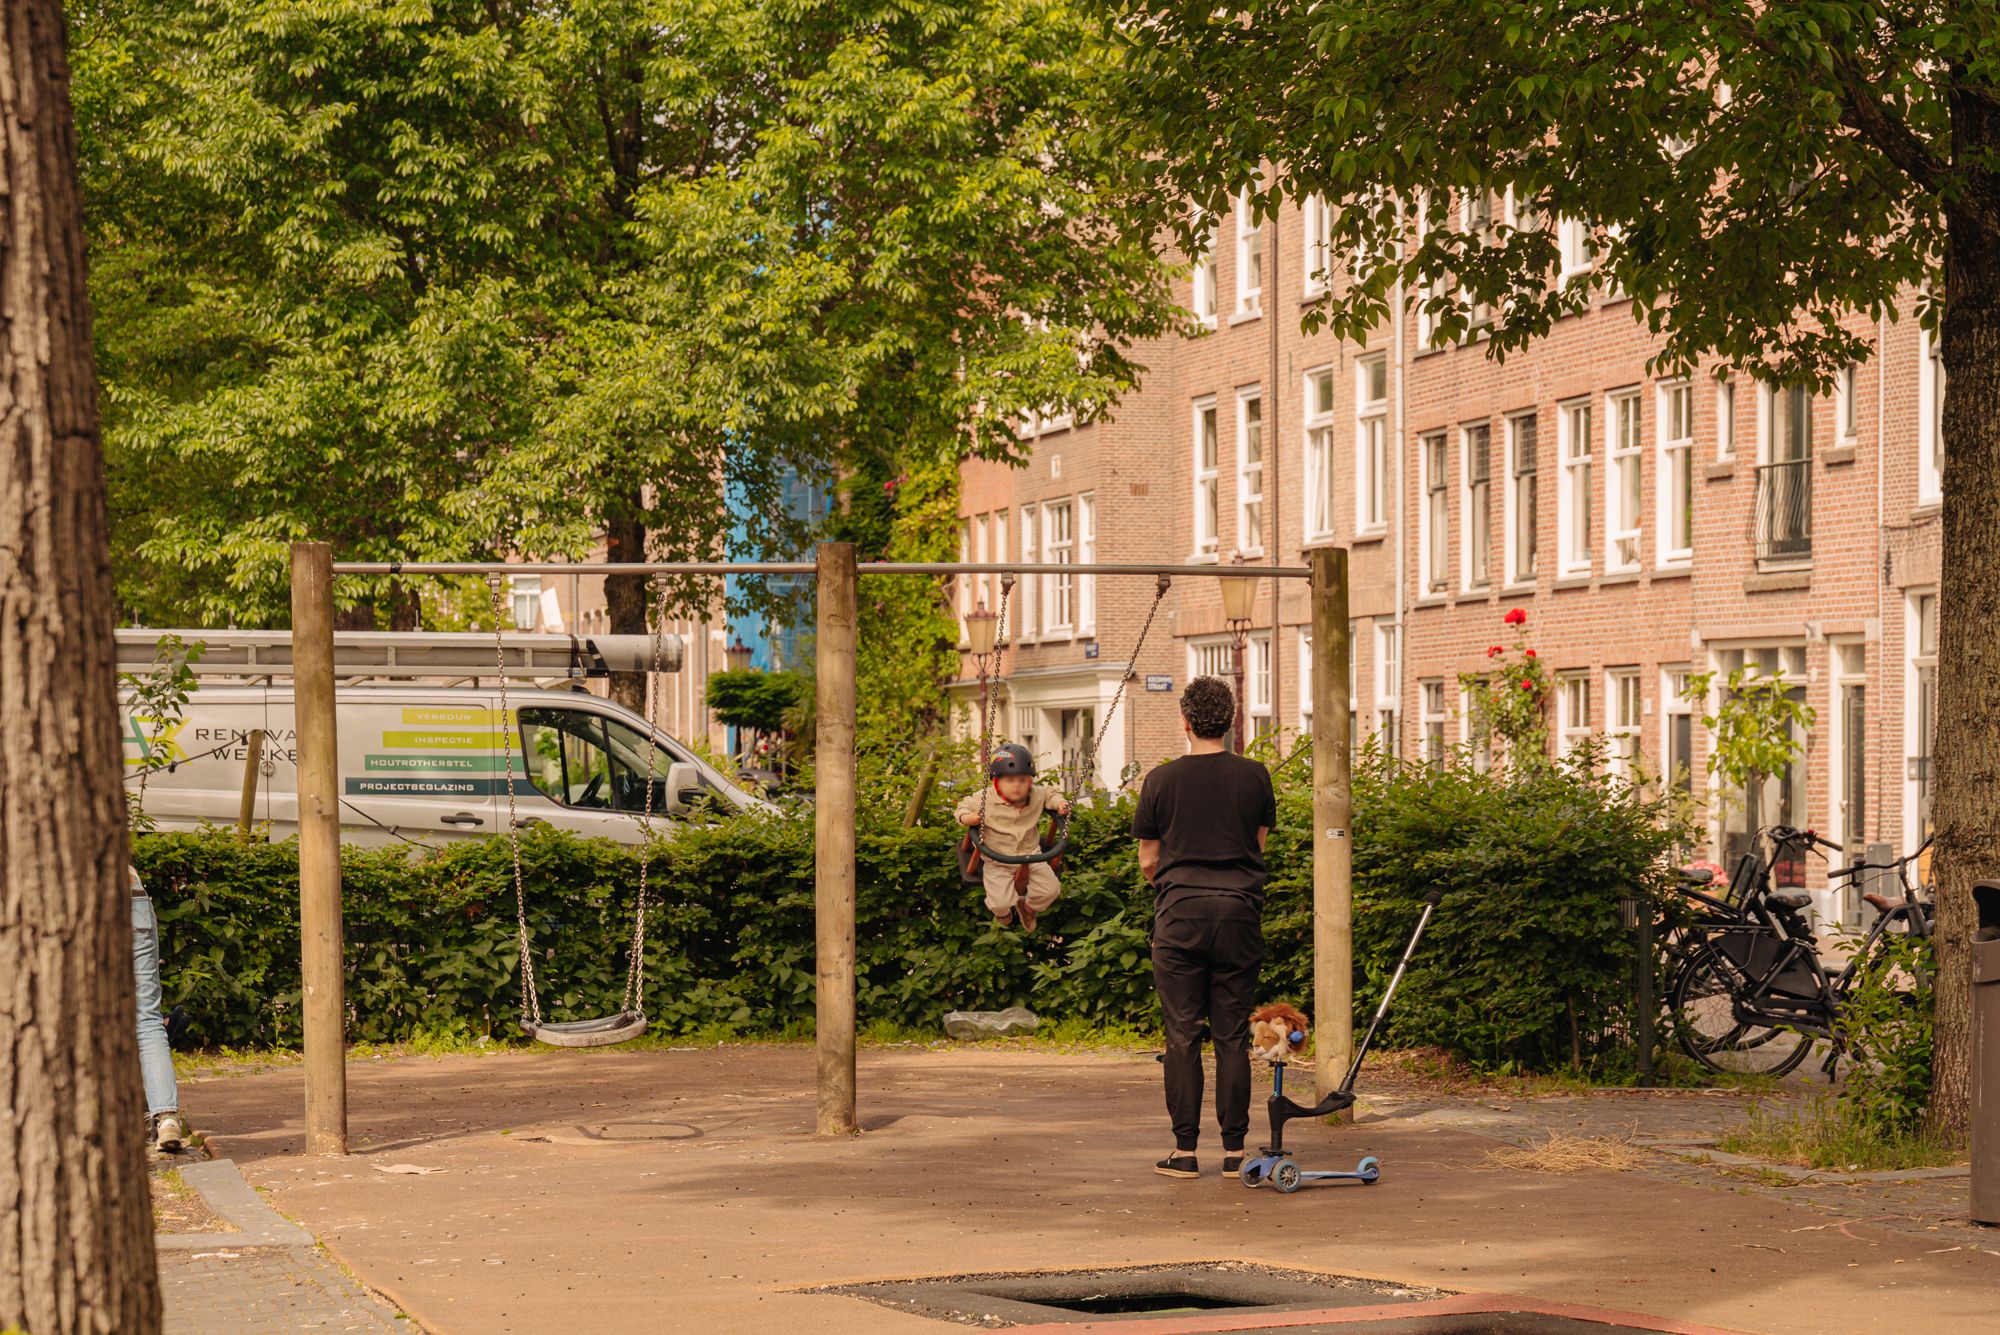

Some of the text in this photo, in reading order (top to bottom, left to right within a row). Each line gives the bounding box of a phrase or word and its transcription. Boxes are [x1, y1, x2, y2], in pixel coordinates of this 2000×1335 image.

[417, 713, 472, 721] VERBOUW
[195, 728, 297, 741] RENVA
[414, 736, 473, 744] INSPECTIE
[370, 759, 473, 767] HOUTROTHERSTEL
[360, 783, 475, 791] PROJECTBEGLAZING
